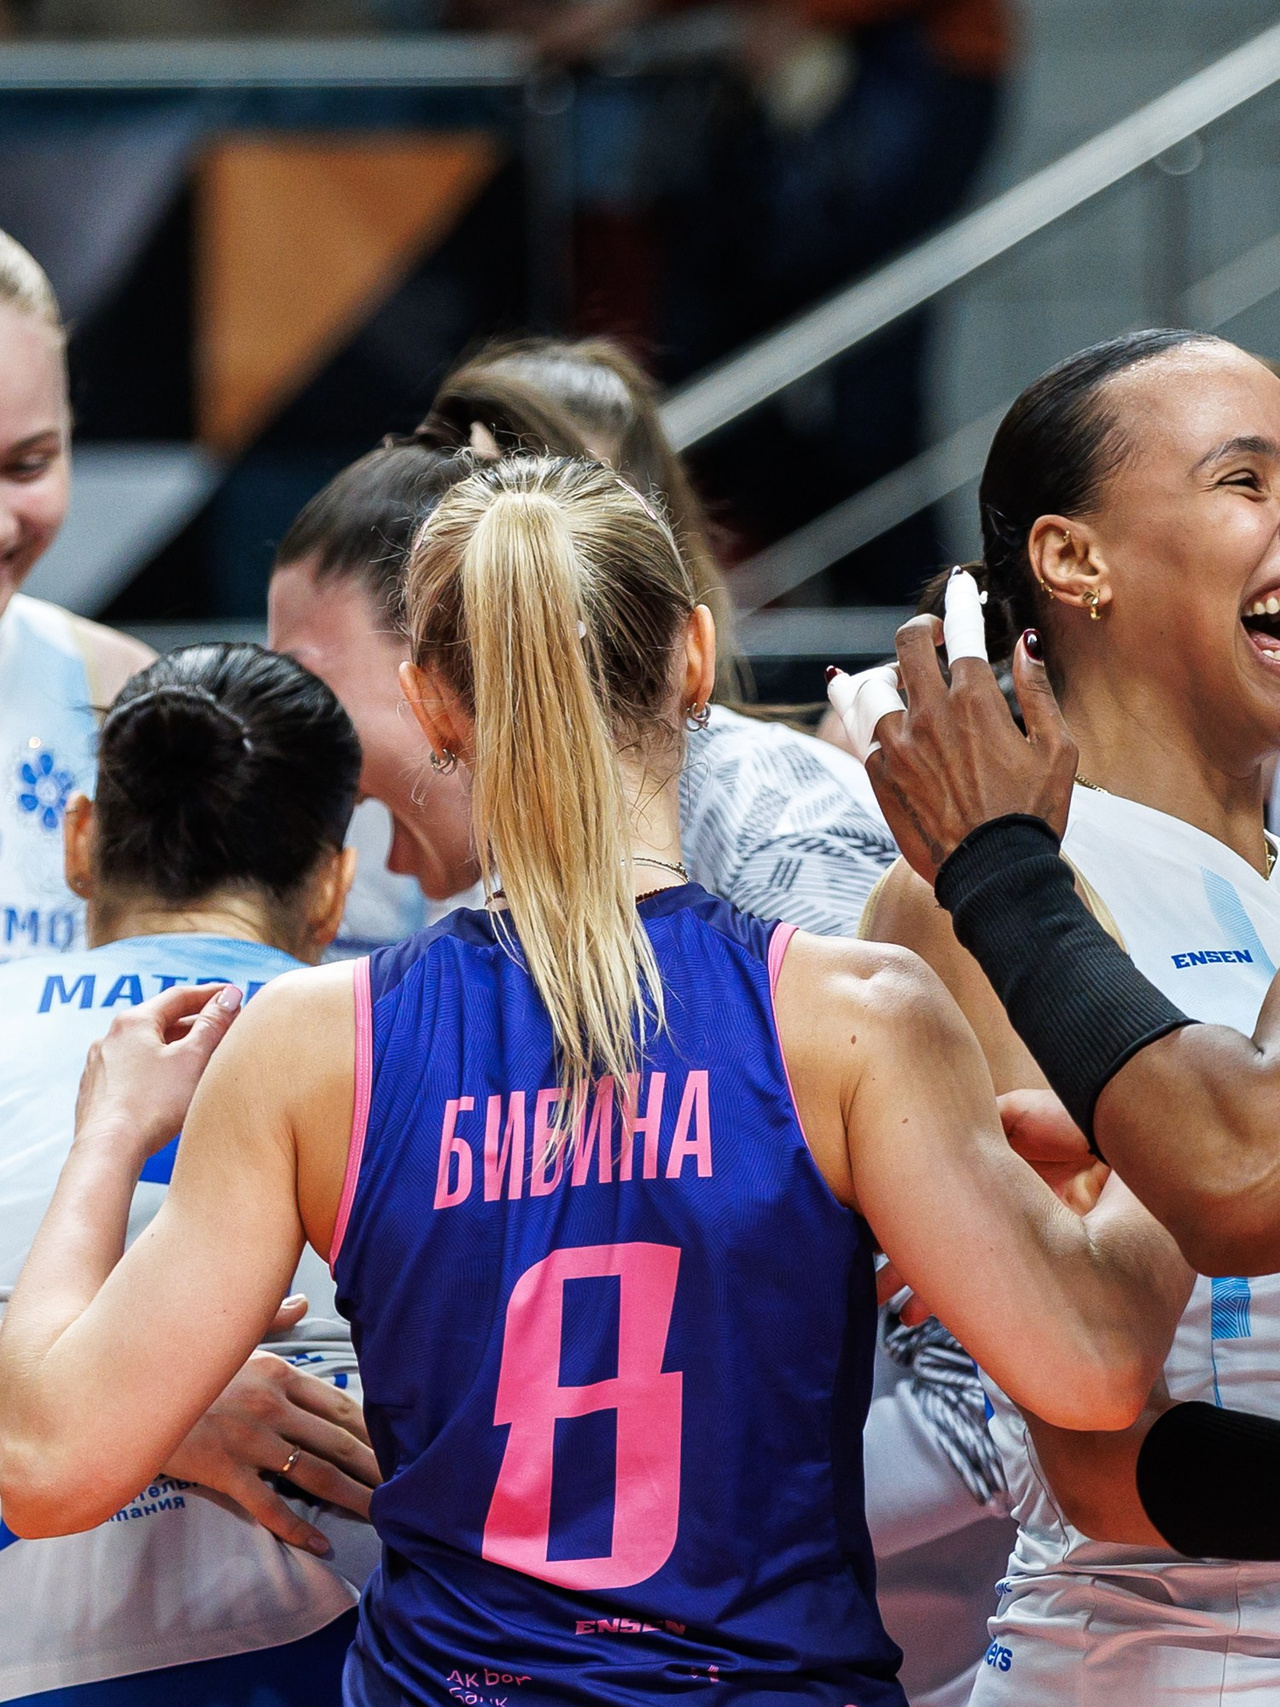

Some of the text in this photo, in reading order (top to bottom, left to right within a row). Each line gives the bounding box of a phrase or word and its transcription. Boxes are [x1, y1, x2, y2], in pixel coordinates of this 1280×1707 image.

[1171, 949, 1254, 969] ENSEN
[37, 971, 268, 1014] МАТ
[433, 1070, 713, 1210] БИБИНА
[481, 1241, 684, 1592] 8
[107, 1496, 186, 1522] пания
[446, 1669, 479, 1688] Ак
